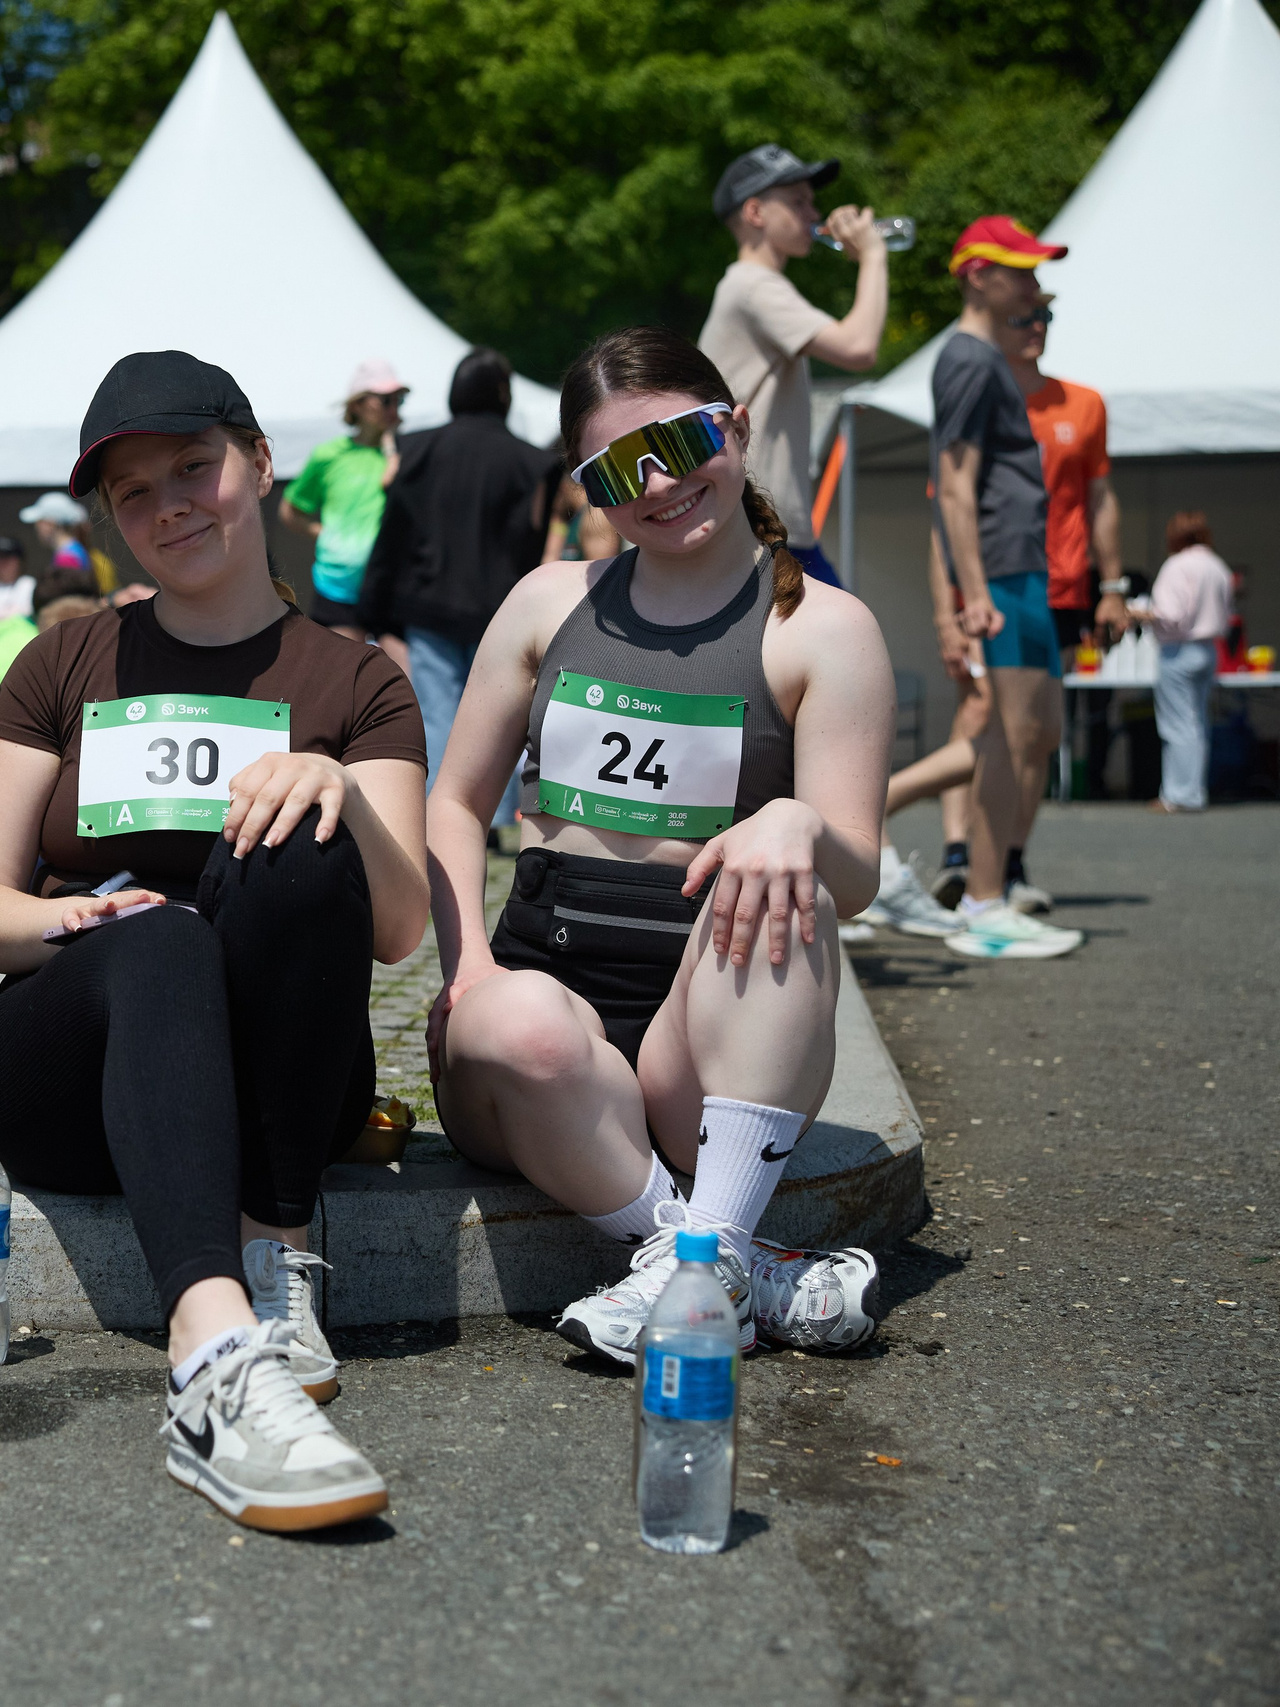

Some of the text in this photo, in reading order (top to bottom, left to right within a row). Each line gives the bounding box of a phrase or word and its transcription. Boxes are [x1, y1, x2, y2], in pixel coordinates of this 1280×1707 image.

[177, 704, 209, 716] Звук
[631, 699, 662, 714] Звук
[145, 737, 220, 786] 30
[597, 731, 669, 791] 24
[668, 811, 688, 820] 30.05
[667, 819, 685, 827] 2026
